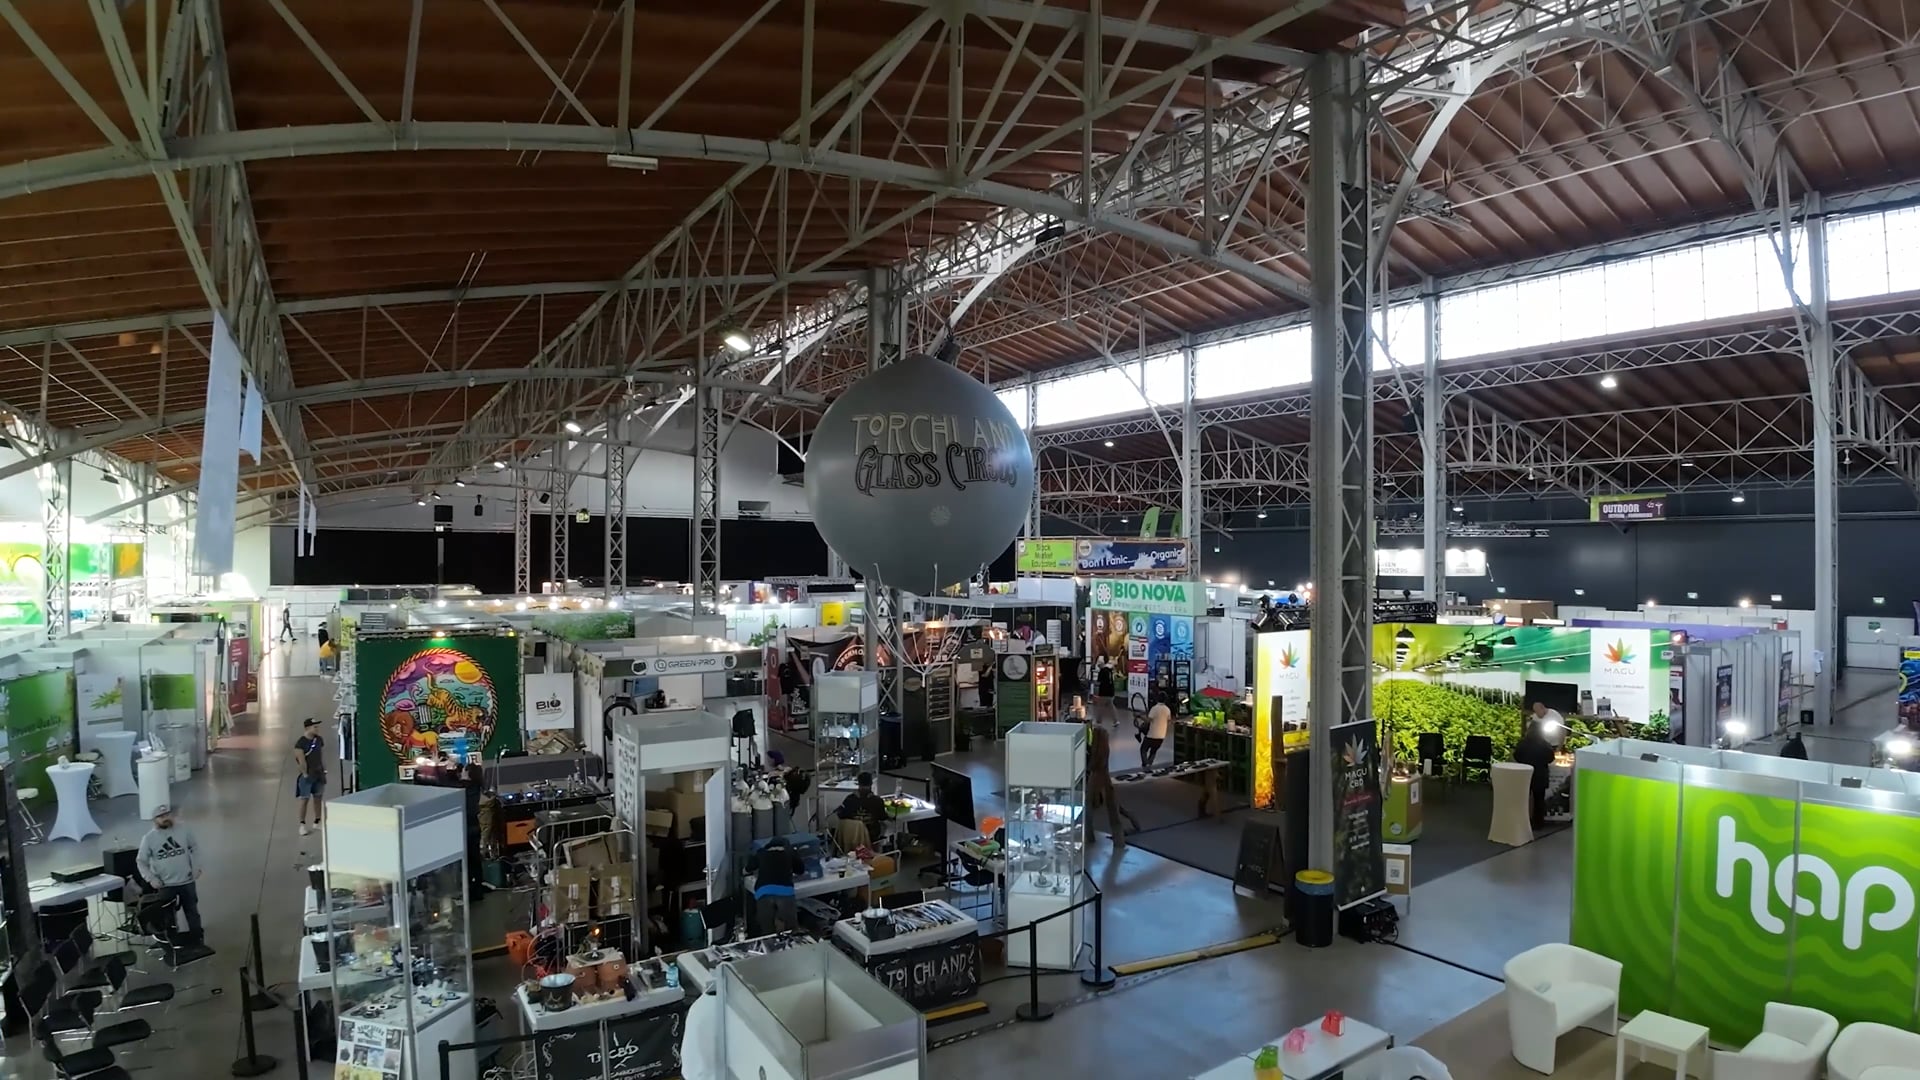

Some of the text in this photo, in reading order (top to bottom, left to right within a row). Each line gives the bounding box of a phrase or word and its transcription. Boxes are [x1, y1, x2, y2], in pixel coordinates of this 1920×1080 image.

[851, 412, 1016, 456] TORCHLAND
[855, 445, 941, 497] GLASS
[1602, 503, 1640, 513] OUTDOOR
[1150, 548, 1182, 560] Organic
[1114, 582, 1186, 603] BIO NOVA
[1604, 667, 1636, 675] MAGU
[1344, 766, 1368, 782] MAGU
[1349, 779, 1365, 789] CBD
[1715, 815, 1916, 950] hap
